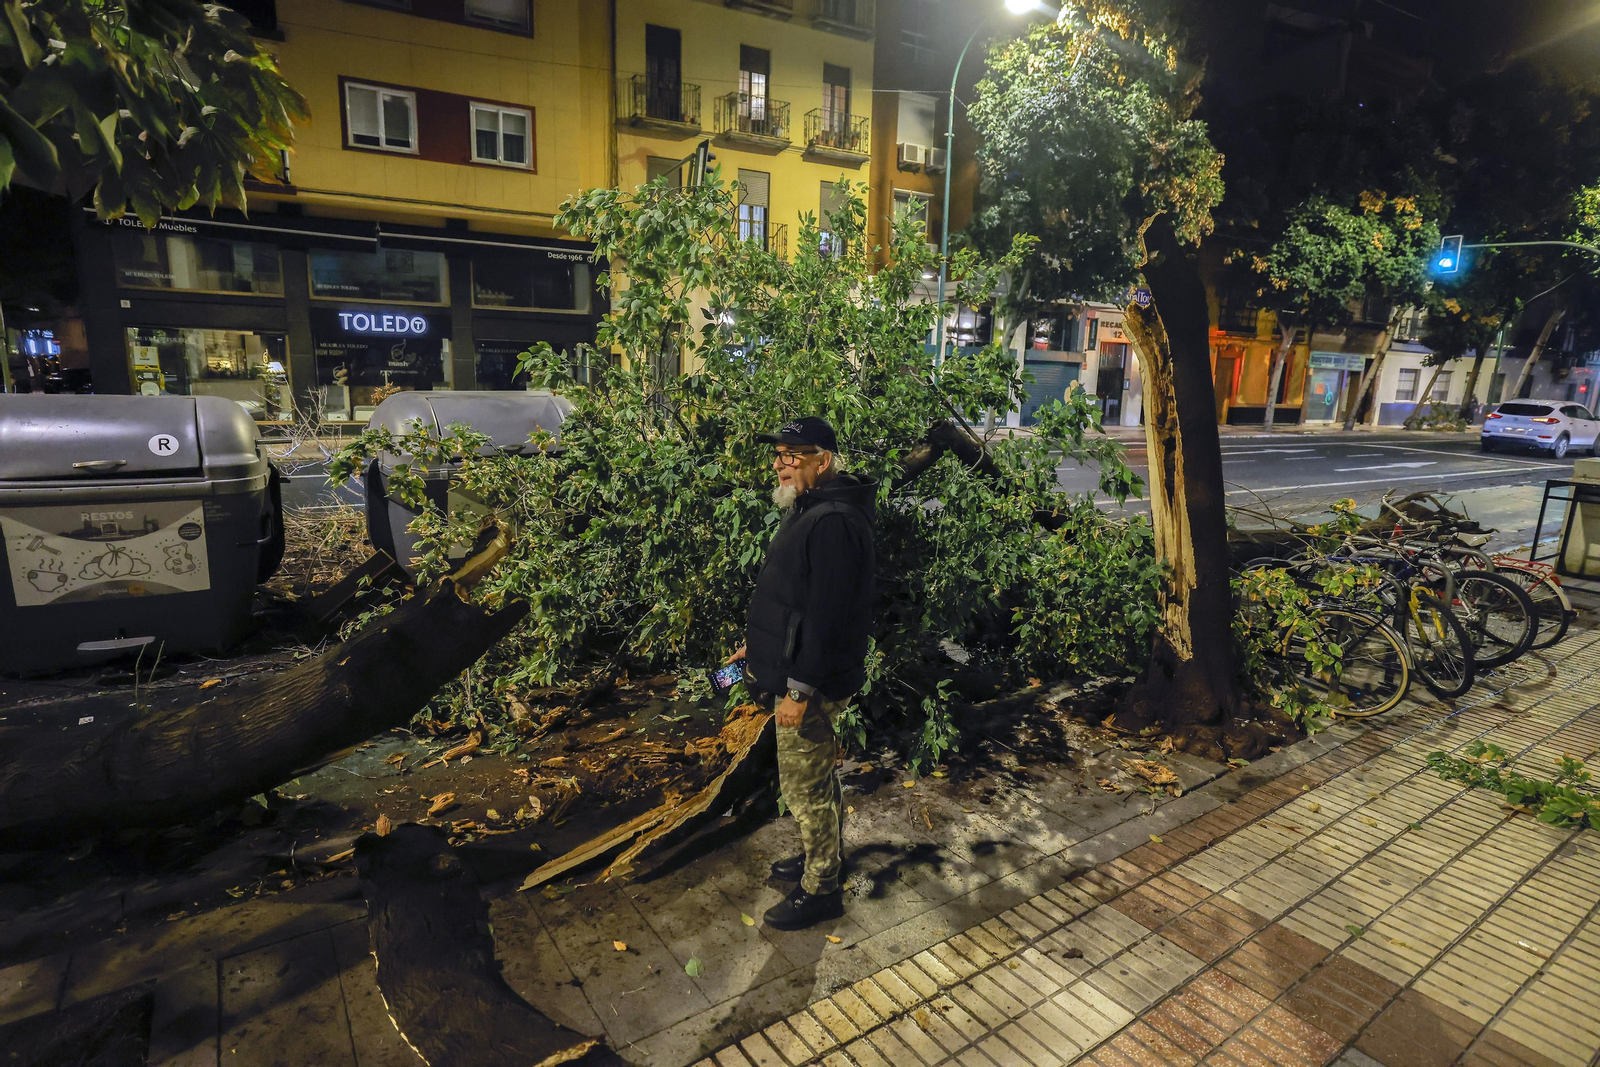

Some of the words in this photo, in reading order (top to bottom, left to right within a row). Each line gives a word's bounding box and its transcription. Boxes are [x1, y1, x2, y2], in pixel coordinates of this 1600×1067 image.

[118, 217, 156, 229] TOLE
[159, 222, 198, 233] Muebles
[547, 251, 568, 260] Desde
[568, 254, 583, 262] 1966
[338, 313, 427, 334] TOLEDO
[1113, 331, 1123, 339] 12
[158, 438, 171, 451] R
[80, 510, 134, 522] RESTOS
